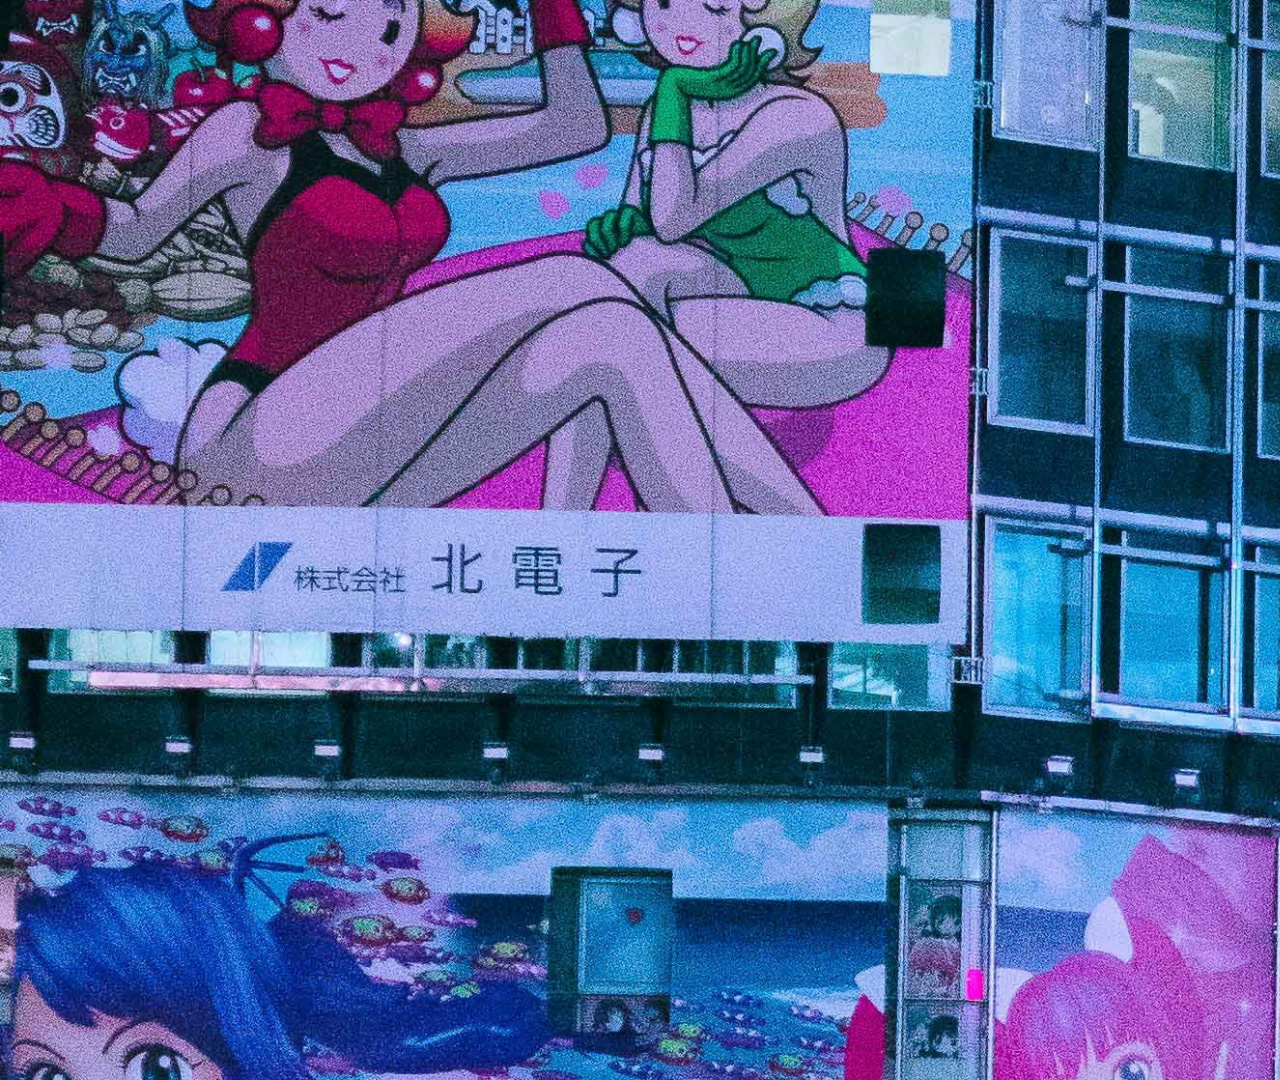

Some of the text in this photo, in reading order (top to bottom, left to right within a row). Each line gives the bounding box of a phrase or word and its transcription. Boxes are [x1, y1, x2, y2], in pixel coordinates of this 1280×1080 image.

[293, 542, 643, 600] 株式会社 北電子
